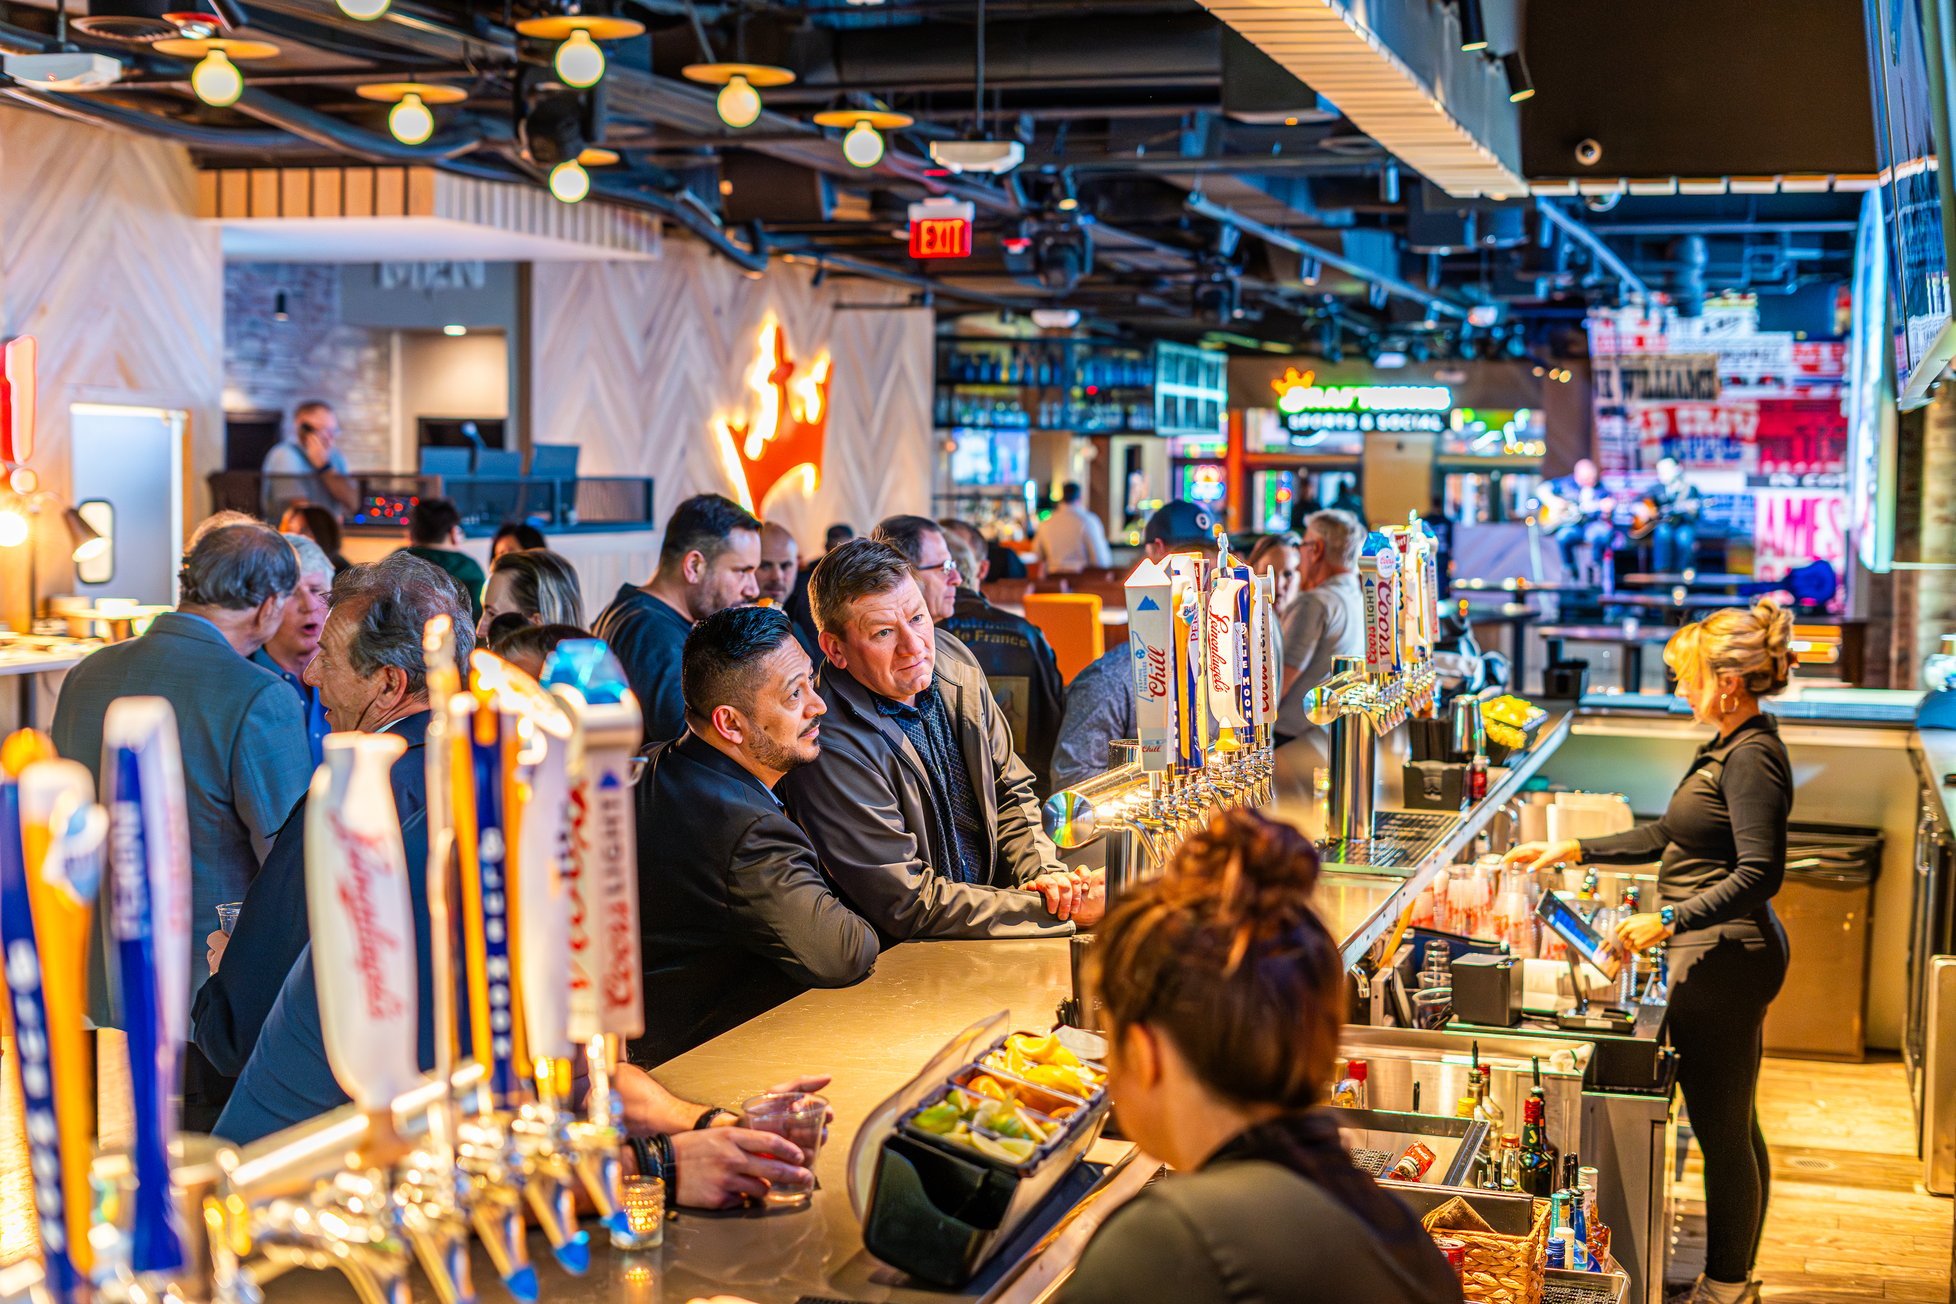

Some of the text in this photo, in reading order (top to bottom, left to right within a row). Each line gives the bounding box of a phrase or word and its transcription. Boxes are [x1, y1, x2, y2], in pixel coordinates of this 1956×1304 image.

[920, 219, 964, 254] EXIT
[1288, 412, 1358, 431] SPORTS
[974, 629, 1029, 647] France
[1209, 605, 1230, 693] Leinenkugel's
[1366, 589, 1378, 664] Coors LIGHT
[1377, 580, 1392, 659] Coors
[1148, 645, 1166, 698] Chill
[1241, 622, 1252, 718] BLUE MOON
